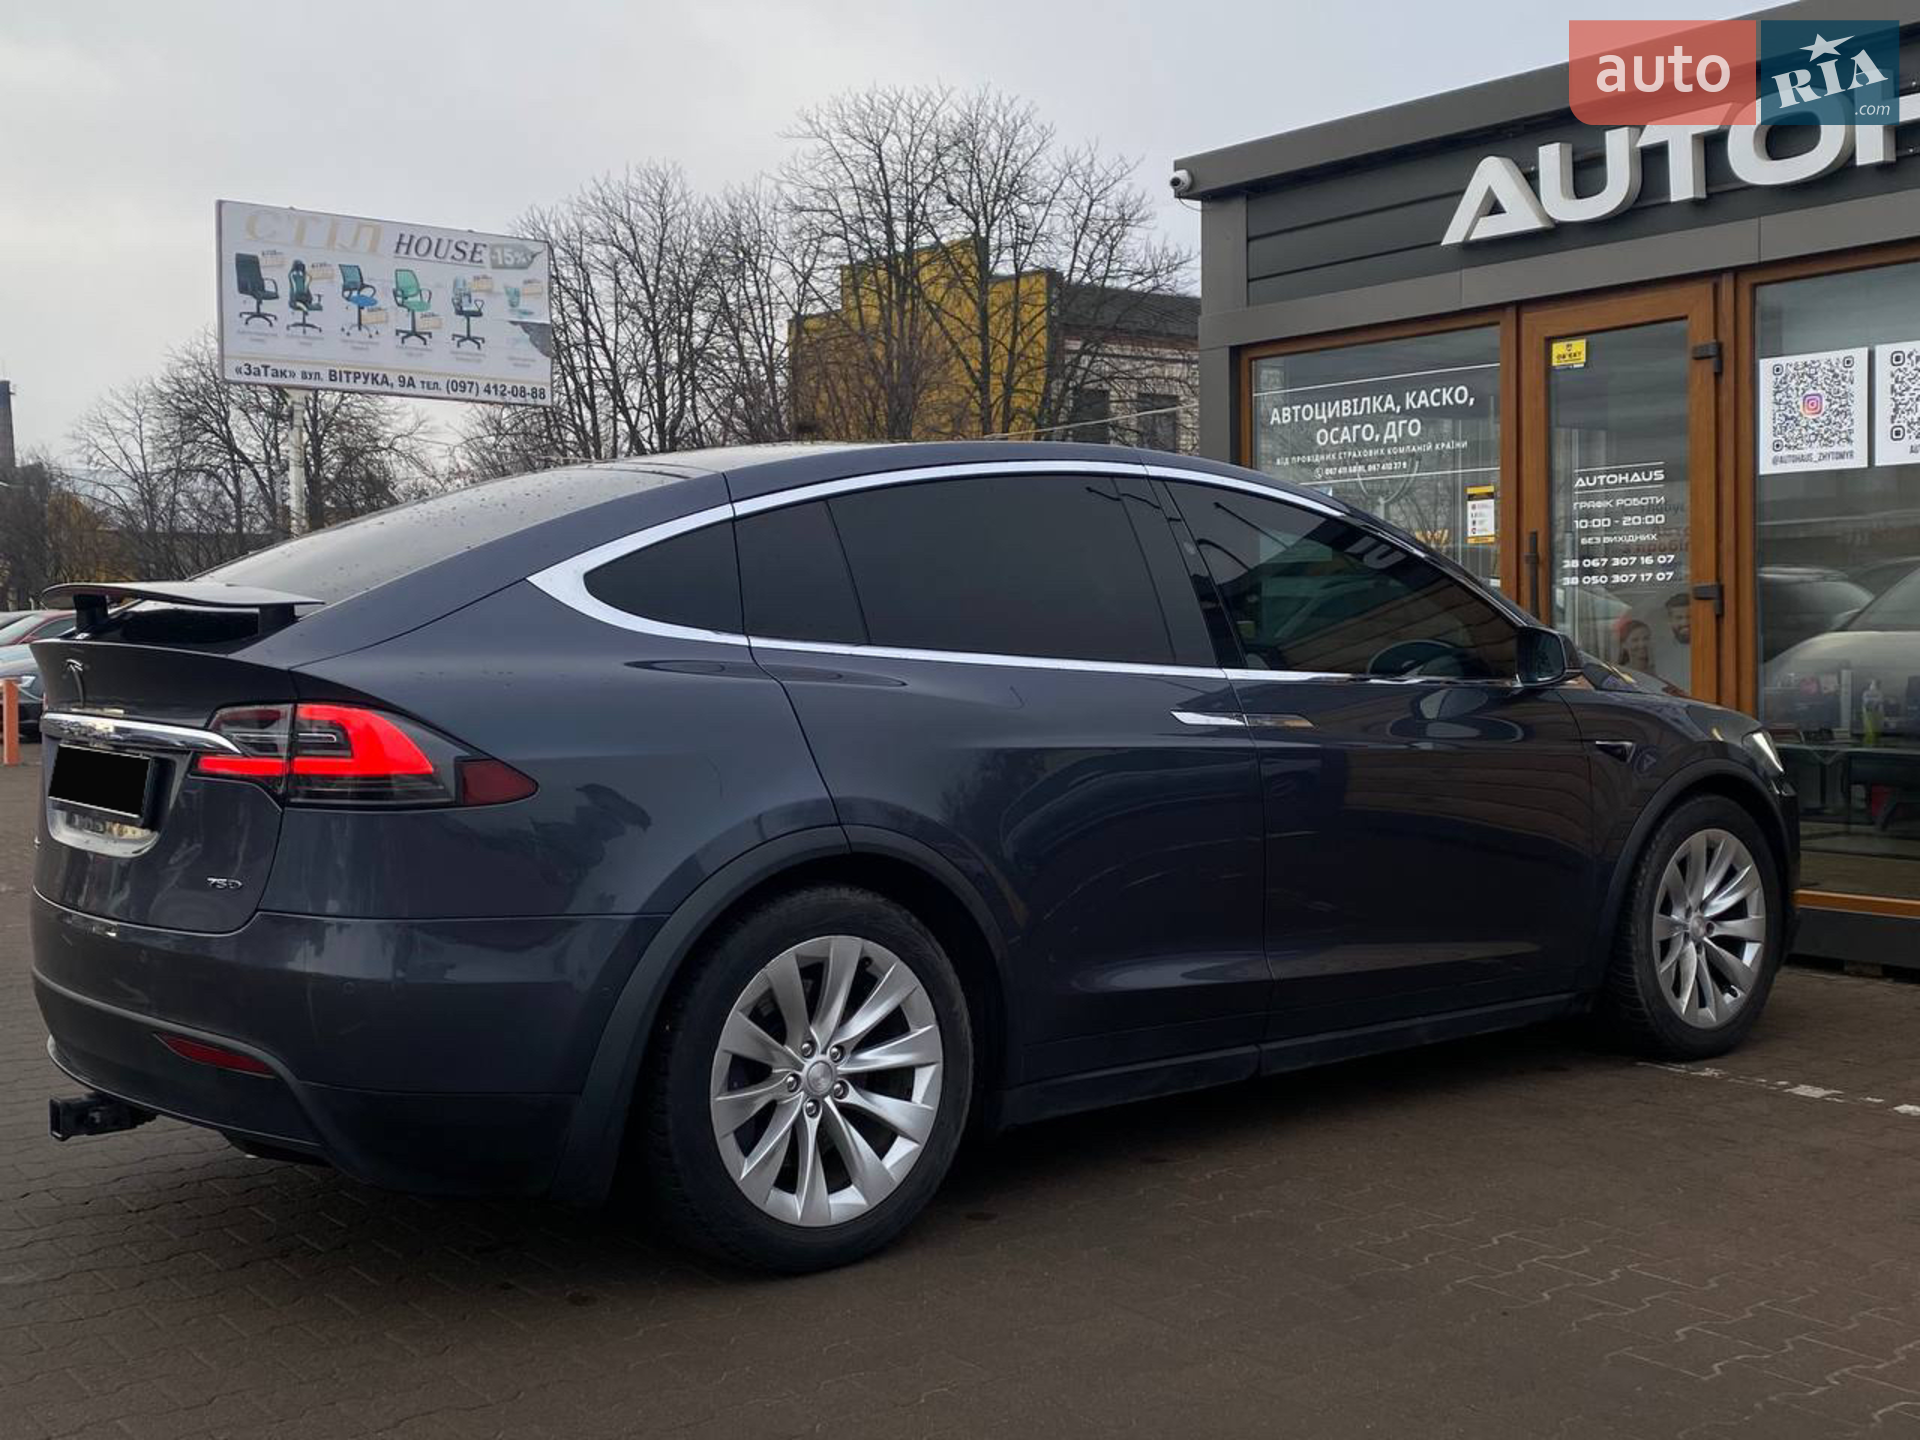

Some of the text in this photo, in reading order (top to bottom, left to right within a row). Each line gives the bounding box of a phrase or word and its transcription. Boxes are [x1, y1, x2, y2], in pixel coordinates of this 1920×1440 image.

[394, 233, 488, 264] HOUSE
[235, 363, 296, 379] «ЗаТак»
[328, 369, 394, 389] ВІТРУКА,
[446, 379, 479, 397] (097)
[483, 383, 546, 400] 412-08-88
[1270, 385, 1475, 426] АВТОЦИВІЛКА, КАСКО,
[1316, 418, 1422, 446] ОСАГО, ДГО
[1575, 469, 1665, 488] AUTOHAUS
[1616, 496, 1665, 508] РОБОТИ
[1574, 518, 1611, 529] 10:00
[1622, 514, 1665, 526] 20:00
[1603, 533, 1657, 544] ВИХІДНИХ
[1582, 558, 1608, 568] 067
[1611, 556, 1637, 566] 307
[1640, 555, 1654, 565] 16
[1657, 554, 1675, 564] 07
[1582, 575, 1608, 585] 050
[1611, 573, 1637, 583] 307
[1640, 573, 1653, 582] 17
[1656, 571, 1674, 581] 07
